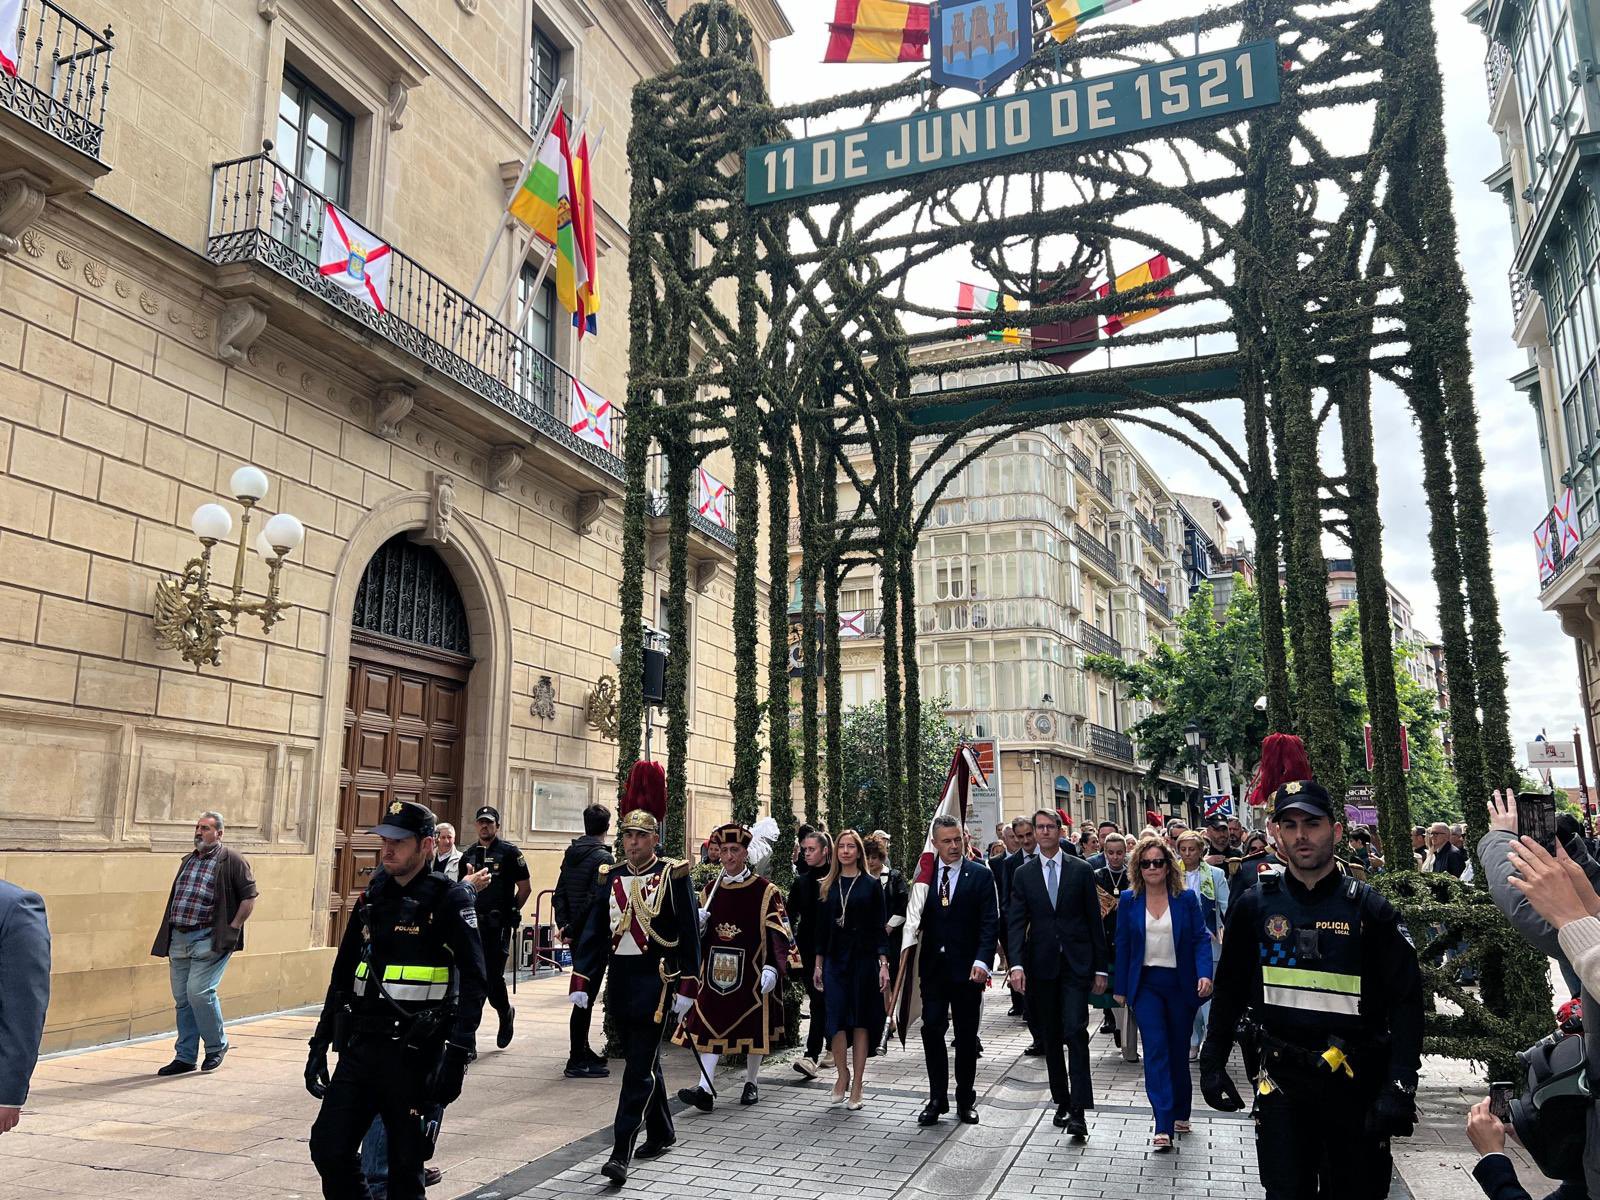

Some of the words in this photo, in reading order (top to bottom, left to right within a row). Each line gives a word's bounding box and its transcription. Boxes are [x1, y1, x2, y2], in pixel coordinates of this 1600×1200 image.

[764, 147, 794, 194] 11
[812, 132, 868, 185] DE
[886, 99, 1030, 169] JUNIO
[1051, 82, 1116, 137] DE
[1135, 53, 1254, 120] 1521
[1315, 921, 1350, 930] POLICIA
[409, 1108, 419, 1116] PL
